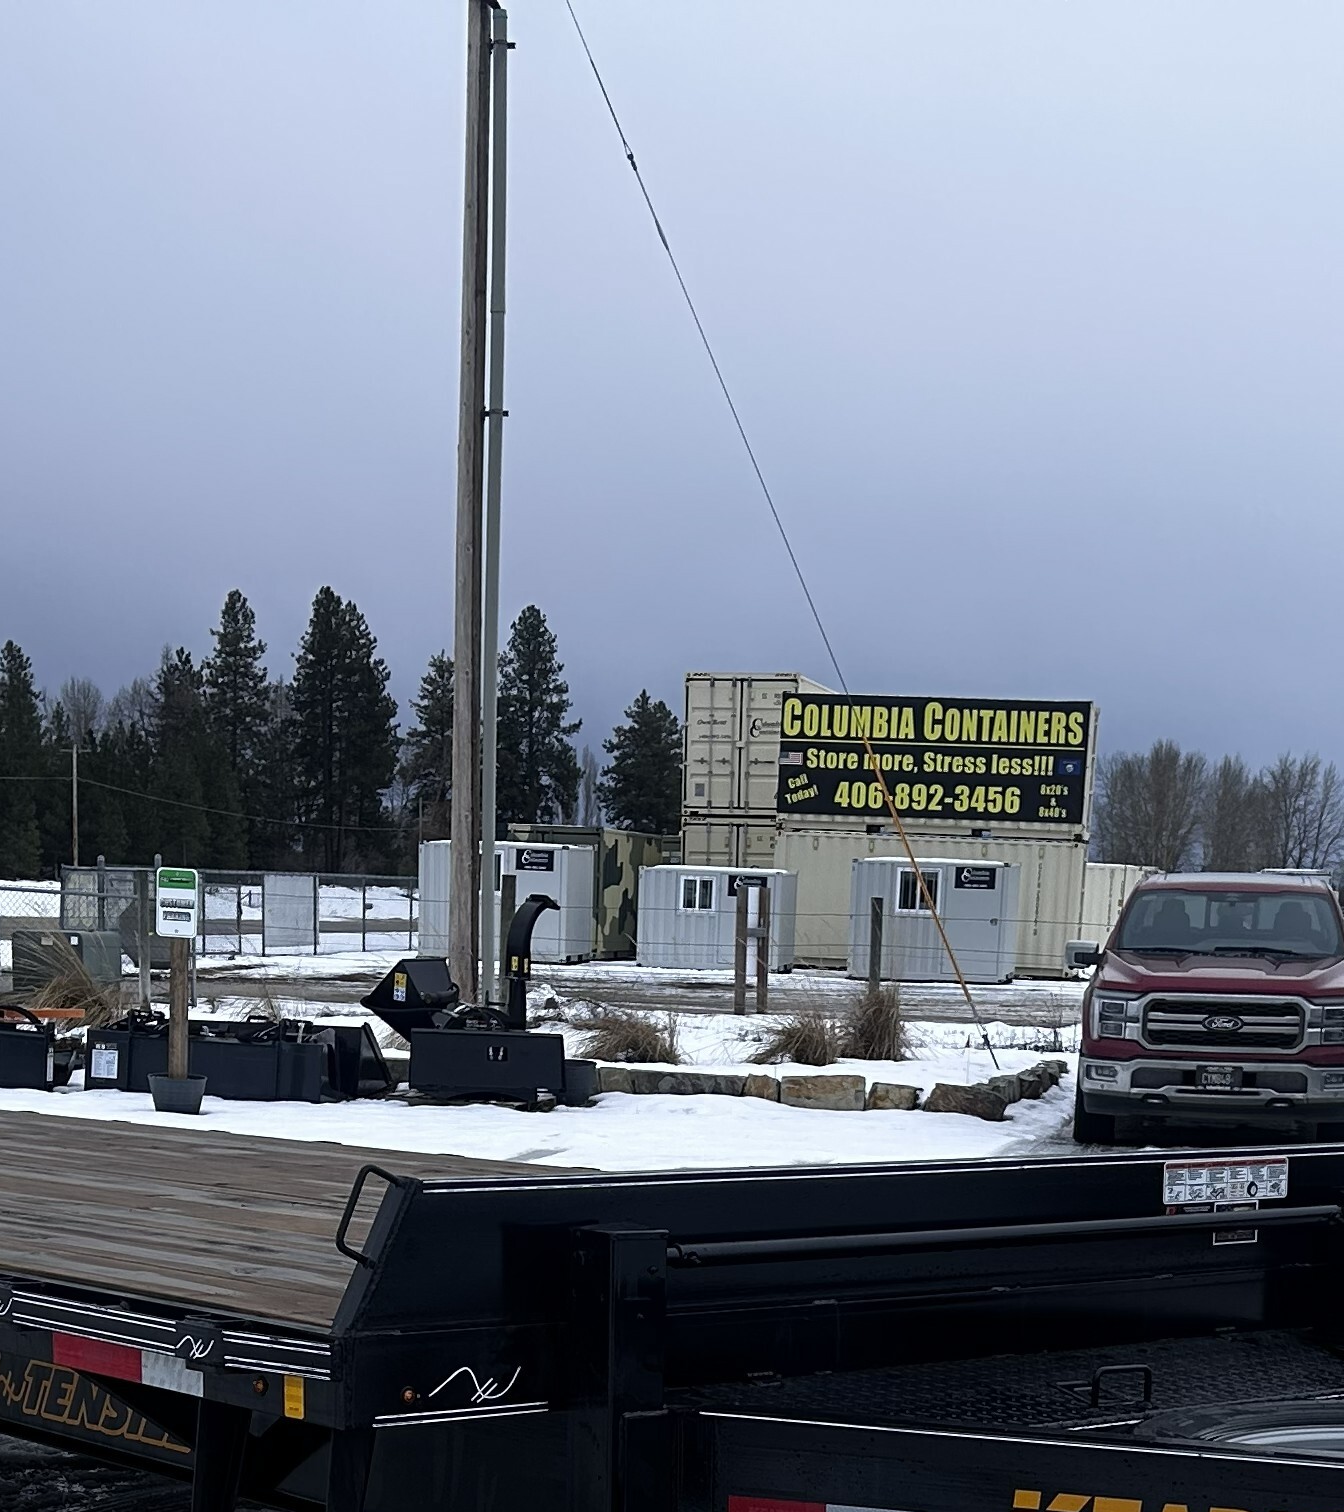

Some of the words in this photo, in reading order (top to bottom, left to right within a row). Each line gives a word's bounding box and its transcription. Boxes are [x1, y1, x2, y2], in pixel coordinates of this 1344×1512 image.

[783, 698, 915, 738] COLUMBIA
[924, 701, 1084, 745] CONTAINERS
[806, 748, 858, 769] Store
[863, 753, 918, 774] more,
[923, 752, 986, 774] Stress
[991, 754, 1054, 776] less!!!
[784, 784, 818, 804] Today!
[788, 773, 809, 789] Call
[834, 781, 1021, 814] 406-892-3456
